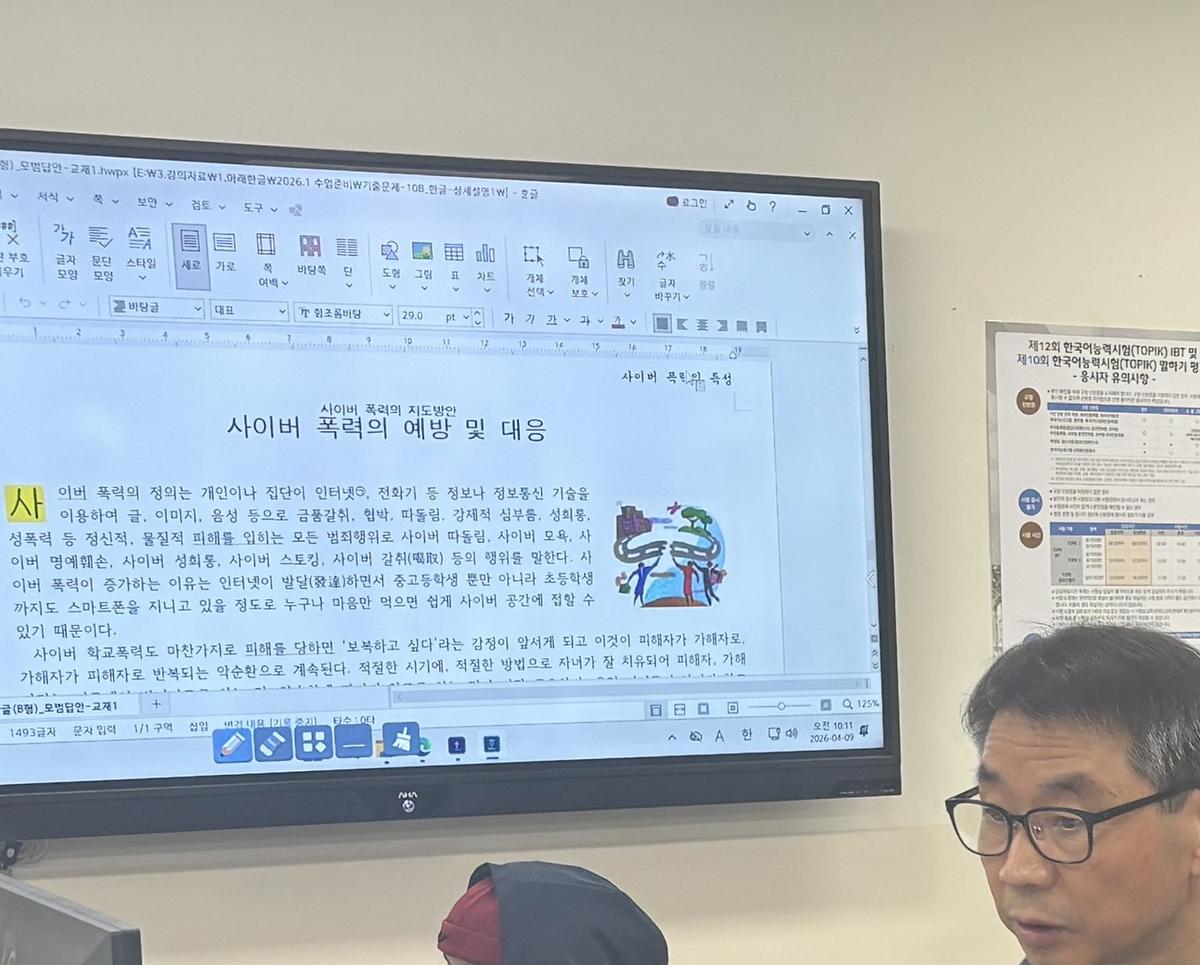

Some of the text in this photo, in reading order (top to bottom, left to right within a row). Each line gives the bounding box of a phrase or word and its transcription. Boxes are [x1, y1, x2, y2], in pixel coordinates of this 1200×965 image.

[138, 197, 157, 208] 보안
[191, 200, 211, 211] 검토
[244, 202, 263, 213] 도구
[56, 254, 76, 266] 글자
[92, 255, 112, 268] 문단
[126, 258, 156, 269] 스타일
[181, 259, 202, 270] 세로
[216, 262, 236, 272] 가로
[344, 267, 352, 277] 단
[58, 269, 78, 280] 모양
[94, 271, 113, 282] 모양
[415, 270, 432, 280] 그림
[451, 271, 459, 280] 표
[618, 277, 635, 286] 찾기
[527, 287, 544, 297] 선택
[215, 305, 234, 315] 대표
[402, 311, 456, 322] 29.0 pt
[1028, 340, 1198, 359] 제12회 한국어능력시험(TOPIK) IBT 및
[1017, 354, 1050, 366] 제10회
[1052, 356, 1157, 372] 한국어능력시험(TOPIK)
[1160, 360, 1187, 372] 말하기
[622, 370, 658, 384] 사이버
[1080, 370, 1149, 385] 응시자 유의사항
[321, 403, 457, 417] 사이버 폭력의 지도방안
[227, 414, 546, 442] 사이버 폭력의 예방 및 대응
[58, 485, 86, 500] 이버
[96, 485, 139, 500] 폭력의
[150, 485, 192, 500] 정의는
[201, 485, 257, 500] 개인이나
[266, 485, 305, 500] 집단이
[377, 485, 416, 500] 전화기
[425, 486, 439, 500] 등
[447, 486, 485, 500] 정보나
[493, 486, 543, 500] 정보통신
[552, 486, 589, 500] 기술을
[10, 488, 43, 519] 사
[60, 508, 117, 523] 이용하여
[211, 508, 237, 523] 음성
[247, 508, 288, 523] 등으로
[452, 507, 490, 522] 강제적
[8, 531, 52, 547] 성폭력
[61, 532, 76, 547] 등
[141, 531, 183, 546] 물질적
[192, 531, 235, 546] 피해를
[243, 530, 284, 545] 입히는
[291, 531, 318, 544] 모든
[326, 530, 394, 544] 범죄행위로
[401, 529, 438, 543] 사이버
[497, 529, 535, 543] 사이버
[579, 528, 591, 542] 사
[10, 554, 39, 570] 이버
[49, 554, 112, 569] 명예훼손,
[122, 553, 164, 568] 사이버
[229, 552, 270, 567] 사이버
[332, 551, 372, 566] 사이버
[451, 551, 476, 565] 등의
[484, 550, 523, 565] 행위를
[531, 550, 572, 564] 말한다.
[580, 550, 591, 564] 사
[12, 577, 41, 593] 이버
[50, 577, 93, 592] 폭력이
[103, 576, 160, 592] 증가하는
[168, 576, 211, 591] 이유는
[218, 575, 273, 590] 인터넷이
[393, 572, 458, 587] 중고등학생
[465, 572, 492, 586] 뿐만
[498, 572, 536, 586] 아니라
[543, 571, 593, 585] 초등학생
[14, 592, 595, 616] 까지도 스마트폰을 지니고 있을 정도로 누구나 마음만 먹으면 쉽게 사이버 공간에 접할 수
[16, 623, 116, 639] 있기 때문이다.
[33, 646, 76, 661] 사이버
[87, 644, 159, 660] 학교폭력도
[167, 643, 237, 658] 마찬가지로
[245, 642, 287, 656] 피해를
[294, 640, 335, 656] 당하면
[471, 636, 508, 650] 감정이
[517, 635, 555, 649] 앞서게
[563, 635, 587, 648] 되고
[594, 634, 630, 648] 이것이
[20, 669, 79, 684] 가해자가
[87, 668, 145, 682] 피해자로
[152, 666, 208, 681] 반복되는
[216, 664, 285, 679] 악순환으로
[293, 661, 350, 676] 계속된다.
[358, 660, 398, 675] 적절한
[456, 658, 493, 672] 적절한
[500, 657, 552, 671] 방법으로
[558, 655, 596, 669] 자녀가
[602, 655, 614, 669] 잘
[622, 654, 669, 667] 치유되어
[722, 652, 746, 665] 가해
[857, 700, 880, 708] 125%
[10, 721, 209, 738] 1493글자 입력 1/1 구역 삽입
[814, 721, 853, 731] 오전 10:11
[715, 730, 724, 742] A
[742, 728, 752, 741] 한
[810, 733, 854, 743] 2026-04-09
